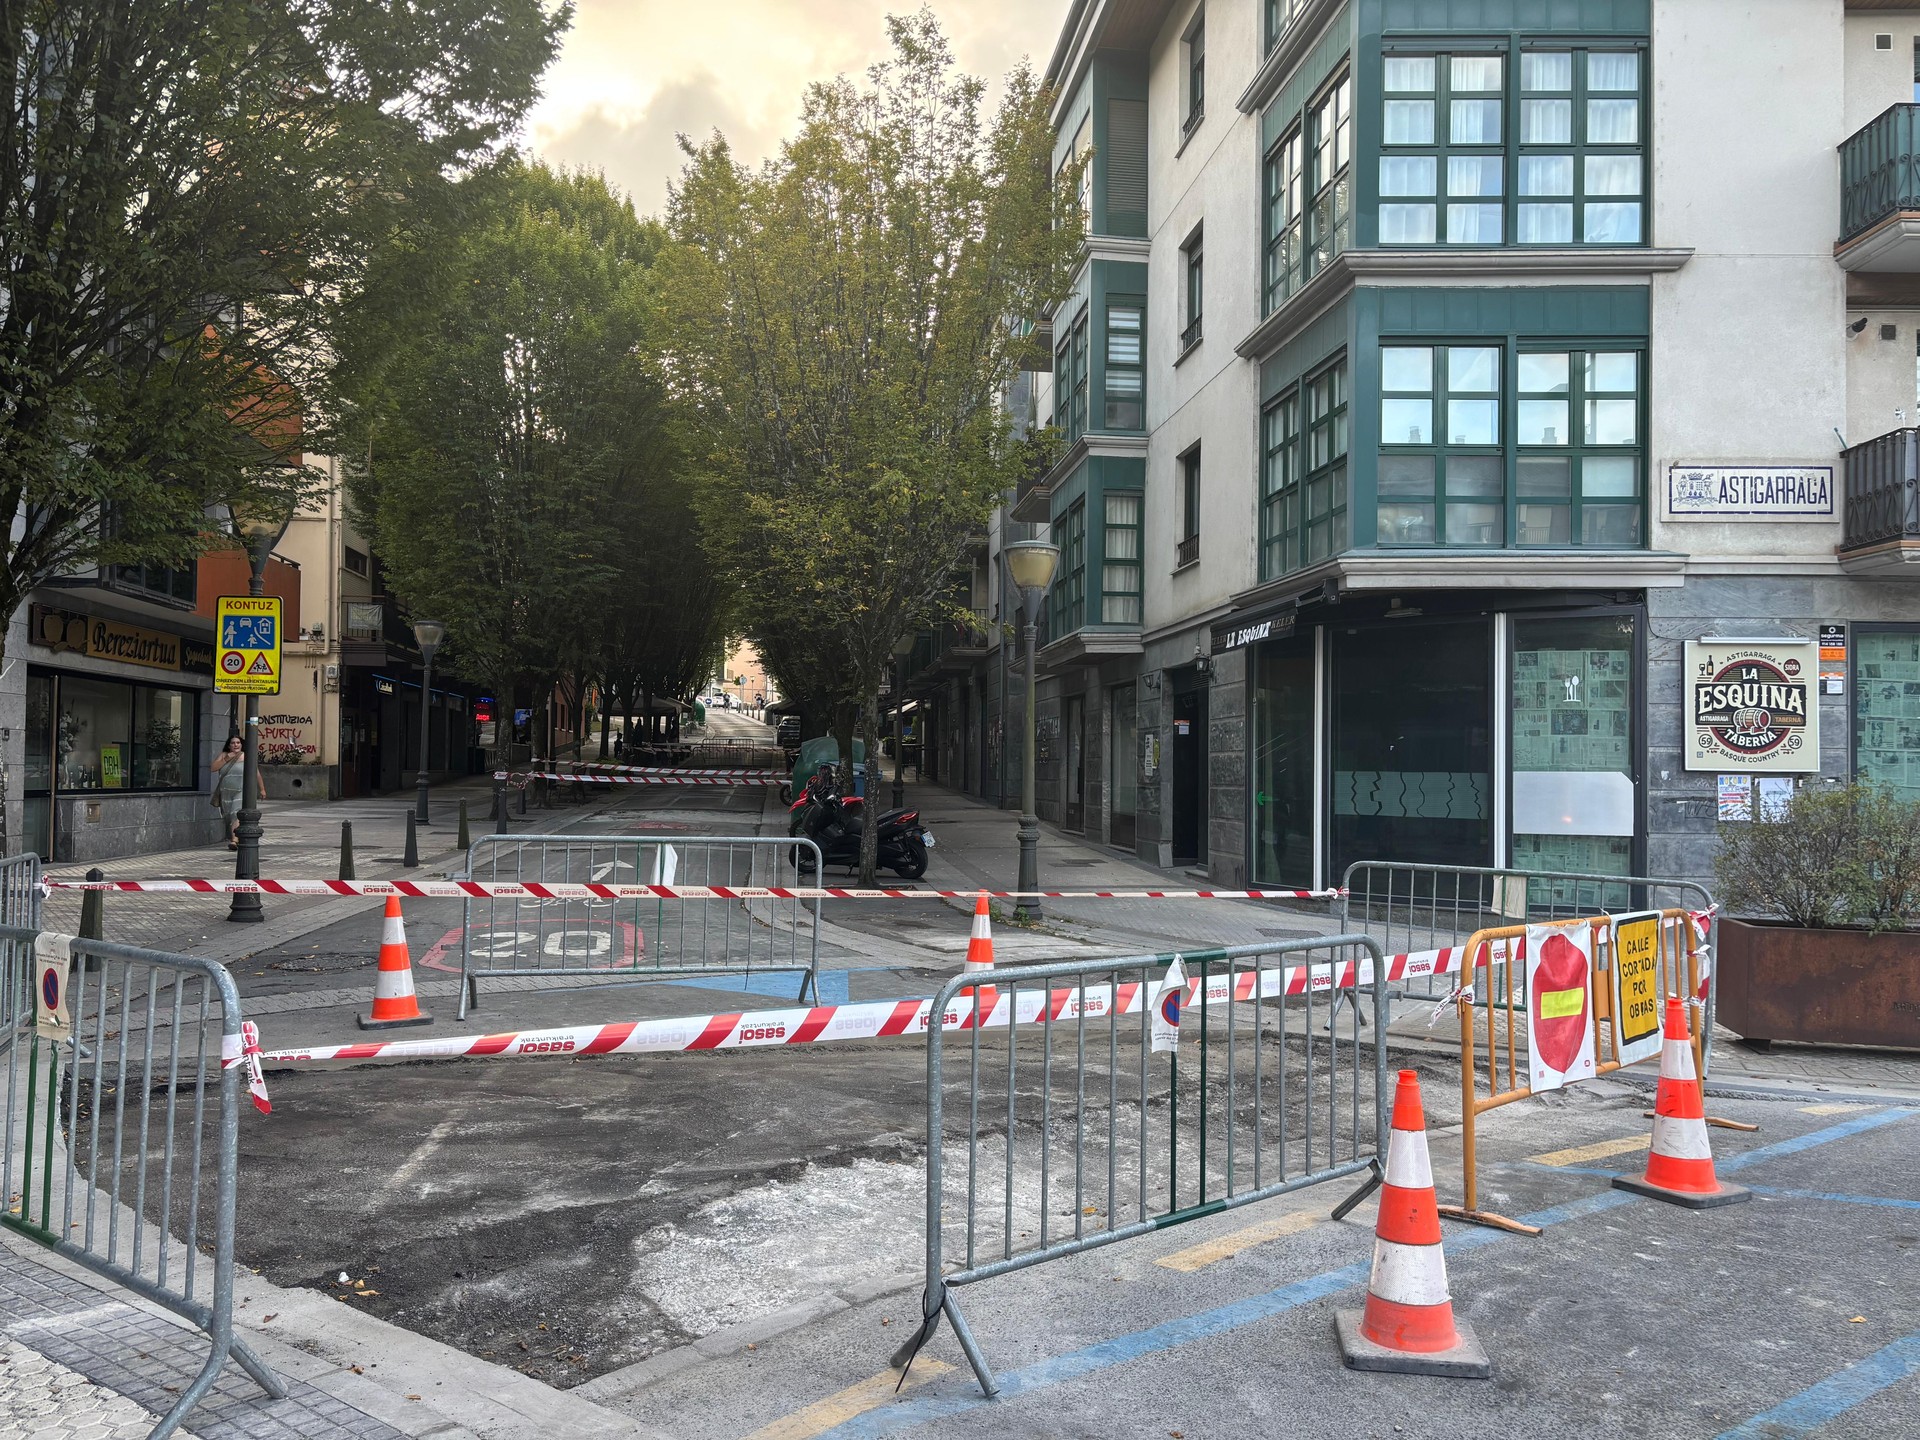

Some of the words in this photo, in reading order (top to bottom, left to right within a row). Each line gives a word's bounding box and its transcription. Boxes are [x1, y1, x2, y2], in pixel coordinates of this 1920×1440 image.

[1718, 476, 1828, 504] ASTIGARRAGA
[225, 600, 273, 610] KONTUZ
[1226, 631, 1236, 648] LA
[1237, 621, 1272, 645] ESQUINA
[92, 621, 177, 666] Bereziartua
[226, 658, 240, 667] 20
[1726, 650, 1776, 664] ASTIGARRAGA
[1742, 667, 1759, 680] LA
[1784, 663, 1800, 672] SIDRA
[1698, 683, 1804, 715] ESQUINA
[258, 714, 313, 725] ONSTITUZIOA
[1700, 714, 1729, 723] ASTIGARRAGA
[1701, 736, 1711, 746] 59
[1723, 728, 1777, 748] TABERNA
[1790, 736, 1800, 747] 59
[1719, 748, 1747, 763] BASQUE
[1748, 749, 1781, 763] COUNTRY
[363, 887, 395, 895] sasoi
[494, 888, 524, 896] sasoi
[469, 931, 610, 957] 20
[1408, 962, 1431, 976] sasoi
[1632, 979, 1647, 997] POR
[740, 1021, 785, 1029] eraikuntzak
[920, 1013, 958, 1030] saoi
[520, 1034, 575, 1044] eraikuntzak
[738, 1026, 786, 1045] sasoi
[517, 1040, 576, 1055] sasoi
